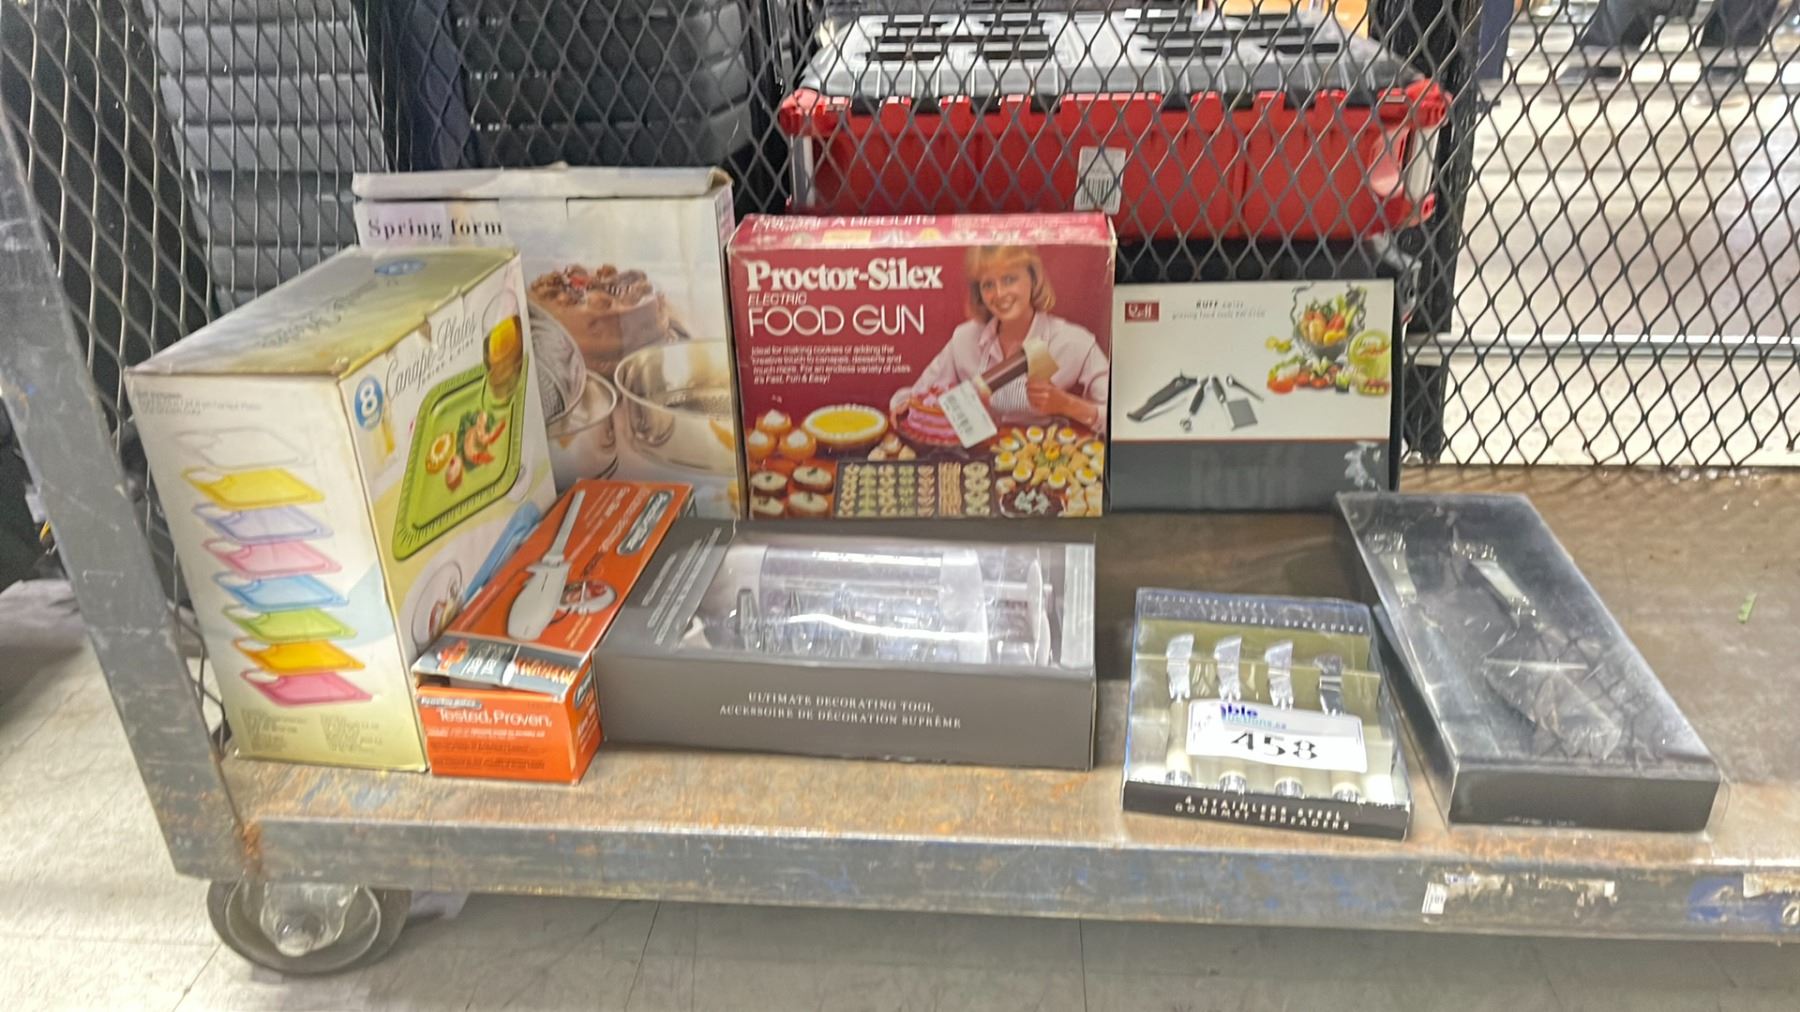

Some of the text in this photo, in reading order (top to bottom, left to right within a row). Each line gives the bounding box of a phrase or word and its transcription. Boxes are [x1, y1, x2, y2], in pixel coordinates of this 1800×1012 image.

[367, 217, 502, 240] Spring form
[748, 258, 943, 291] Proctor-Silex
[748, 291, 807, 305] ELECTRIC
[749, 304, 925, 336] FOOD GUN
[360, 383, 378, 416] 8
[720, 703, 793, 718] ACCESSOIRE
[798, 707, 813, 720] DE
[748, 691, 934, 712] ULTIMATE DECORATING TOOL
[1231, 731, 1319, 762] 458
[1175, 802, 1350, 831] GOURMET SPREADERS
[1202, 797, 1287, 814] STAINLESS
[1298, 807, 1341, 821] STEEL
